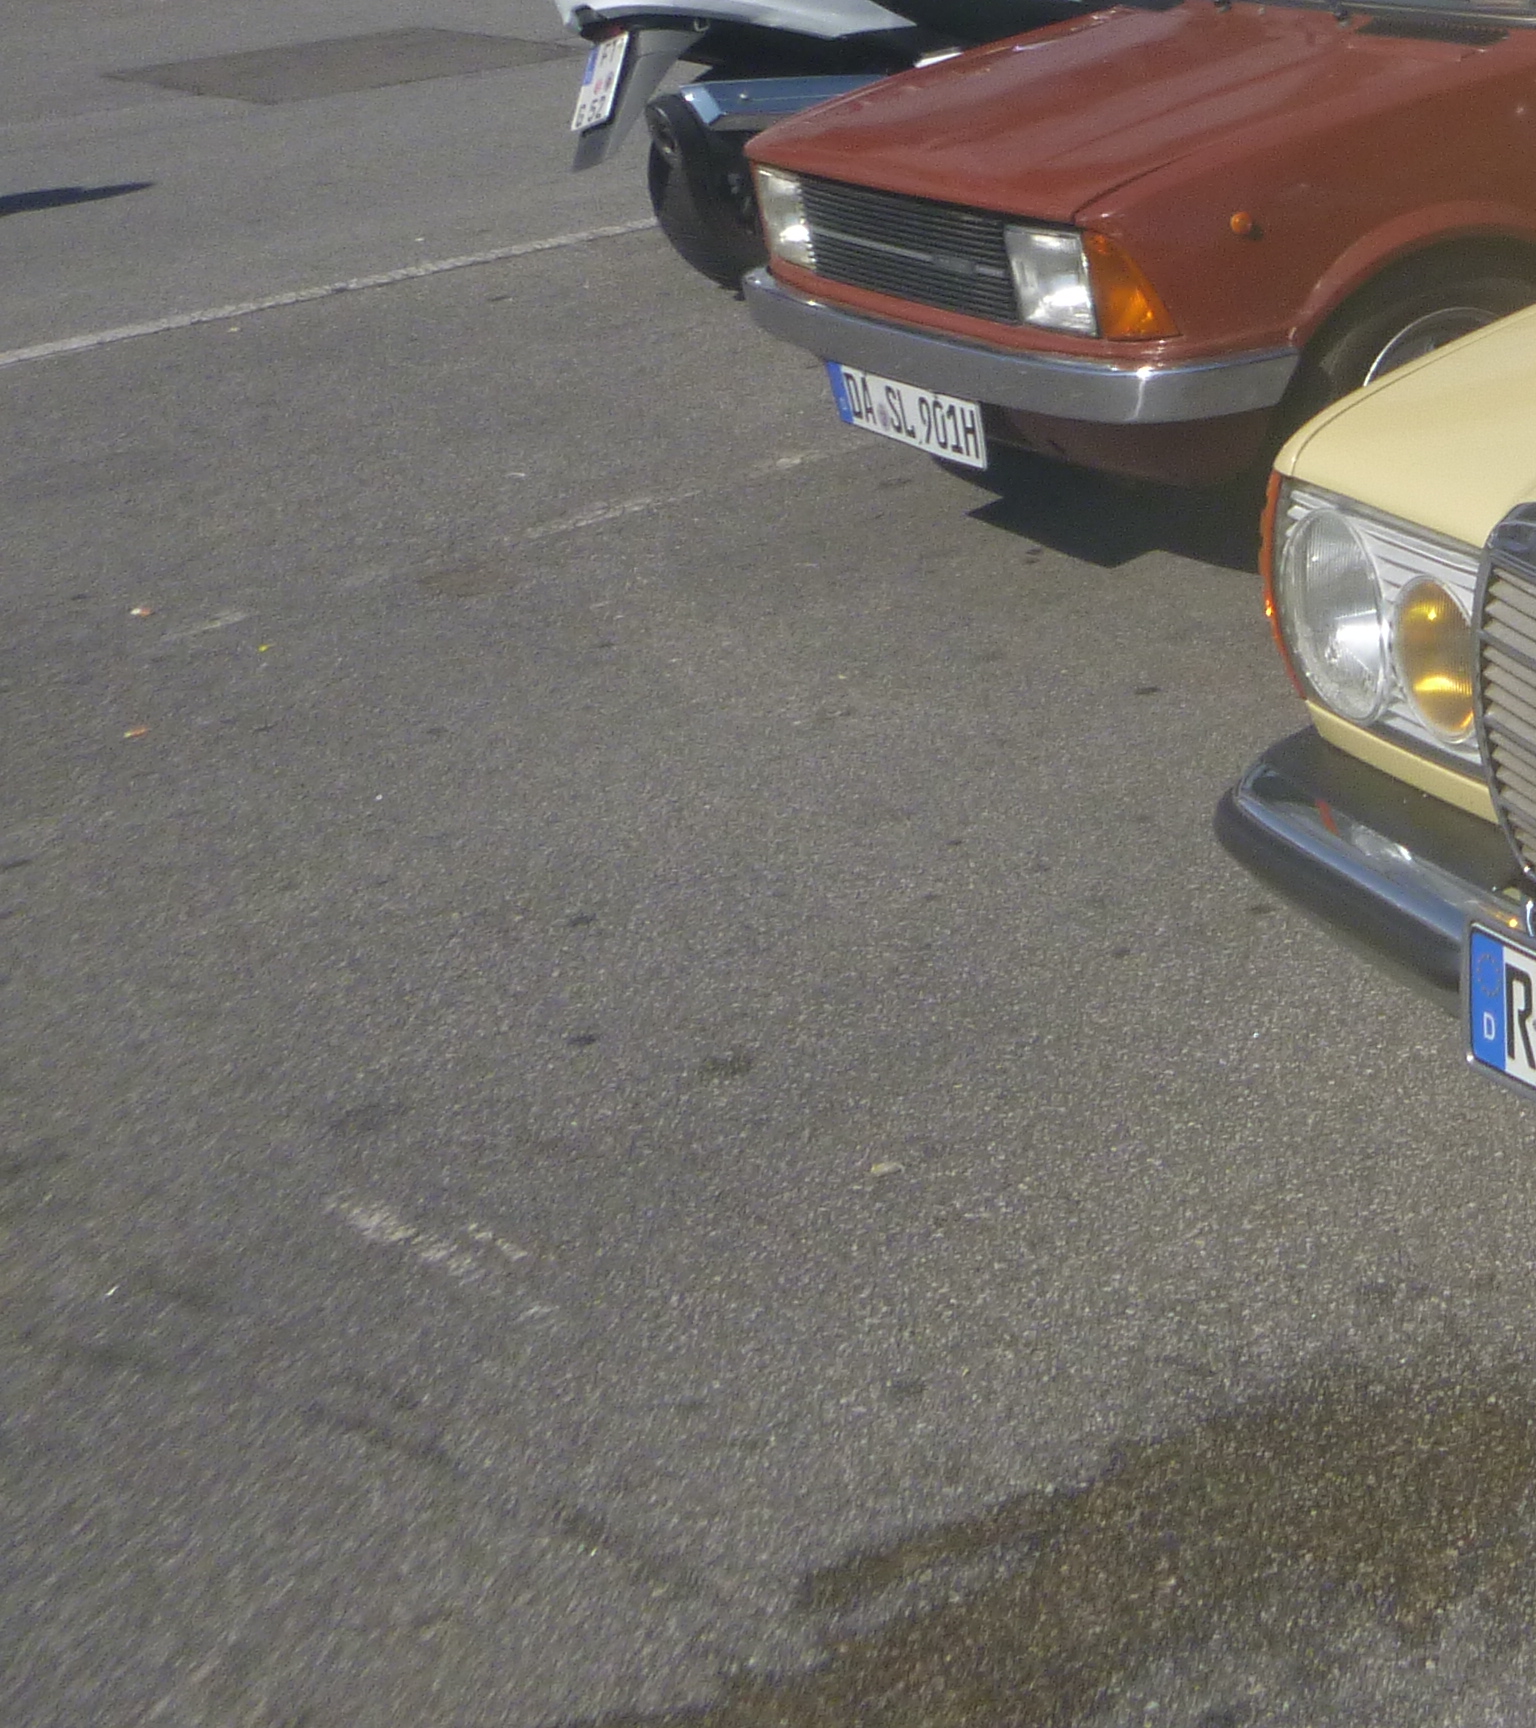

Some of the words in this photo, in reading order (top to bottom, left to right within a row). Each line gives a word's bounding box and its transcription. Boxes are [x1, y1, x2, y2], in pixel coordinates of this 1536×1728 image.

[844, 373, 877, 425] DA
[885, 385, 916, 439] SL
[918, 396, 980, 459] 901H
[1483, 1012, 1496, 1040] D
